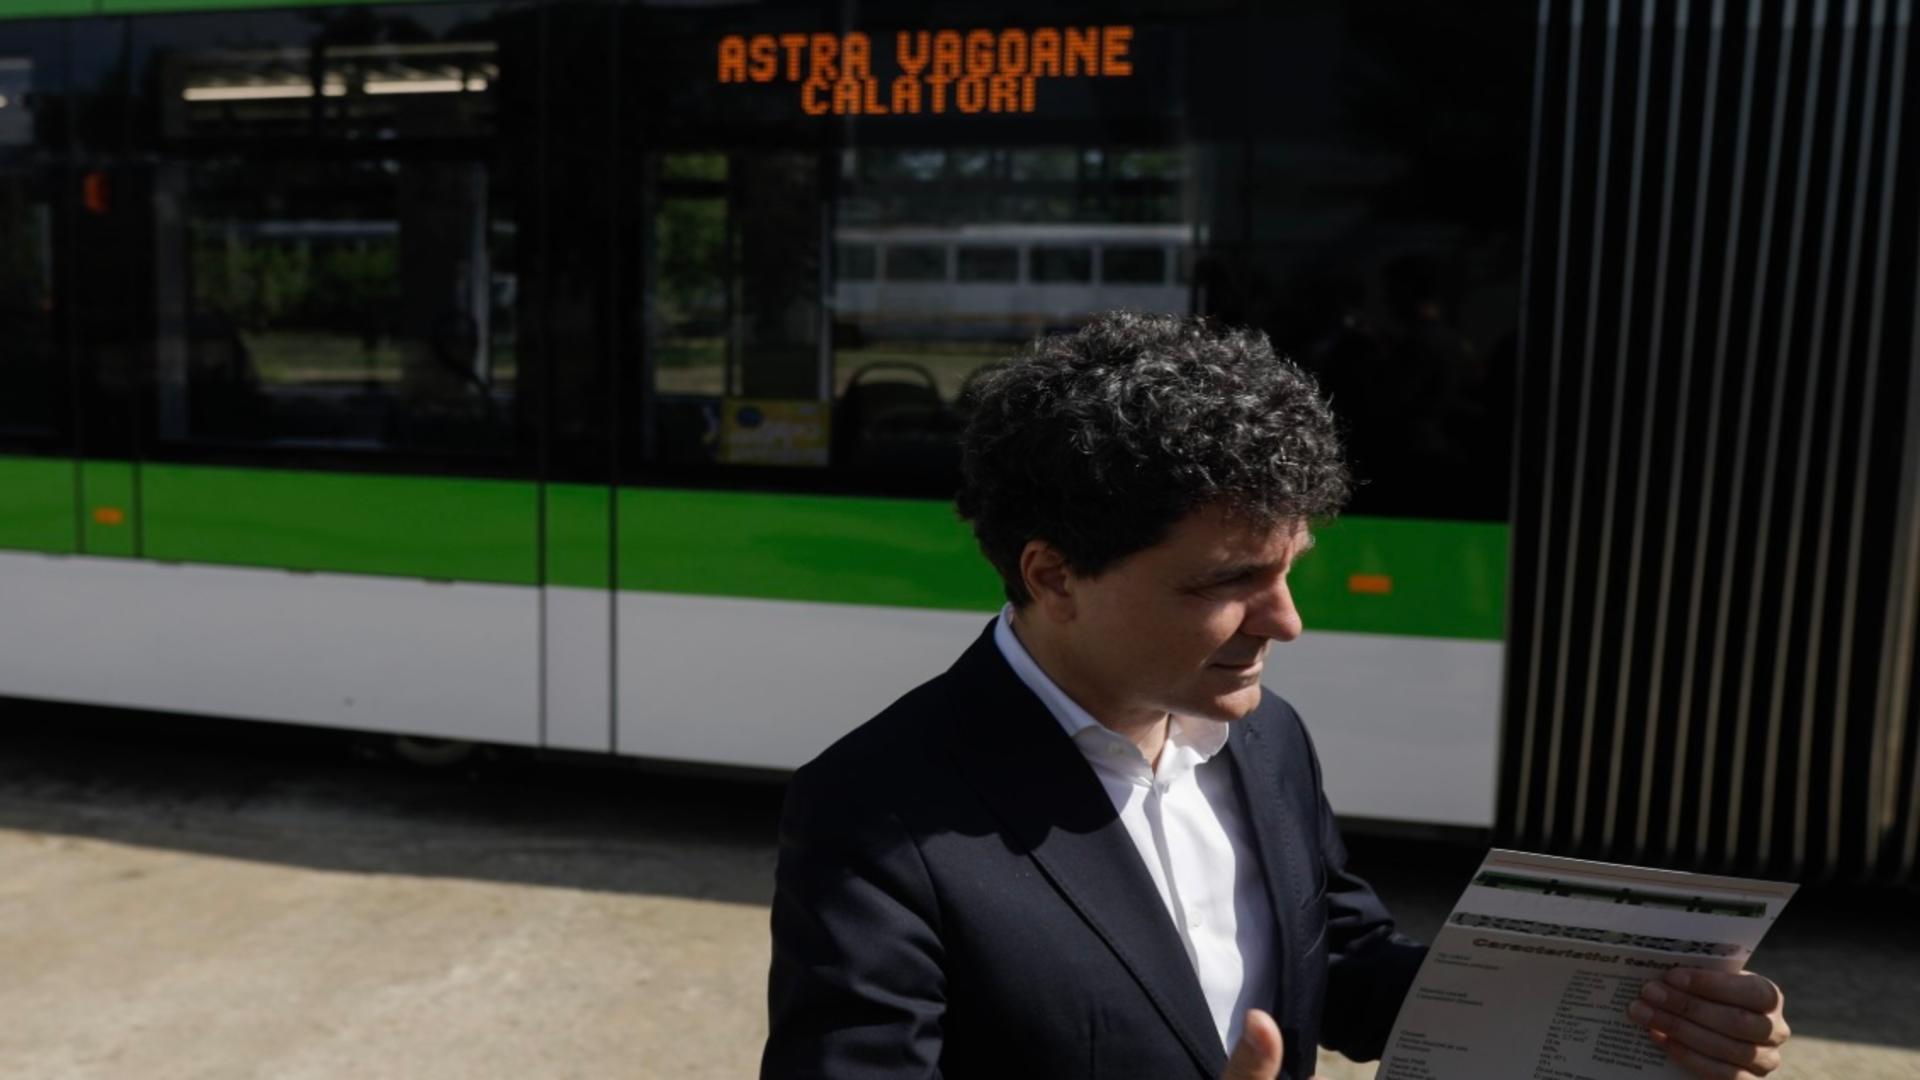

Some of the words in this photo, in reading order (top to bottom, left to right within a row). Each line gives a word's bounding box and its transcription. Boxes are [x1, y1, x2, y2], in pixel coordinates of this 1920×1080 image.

[718, 32, 872, 82] ASTRA
[897, 26, 1132, 76] VAGOANE
[801, 74, 1036, 115] CALATORI
